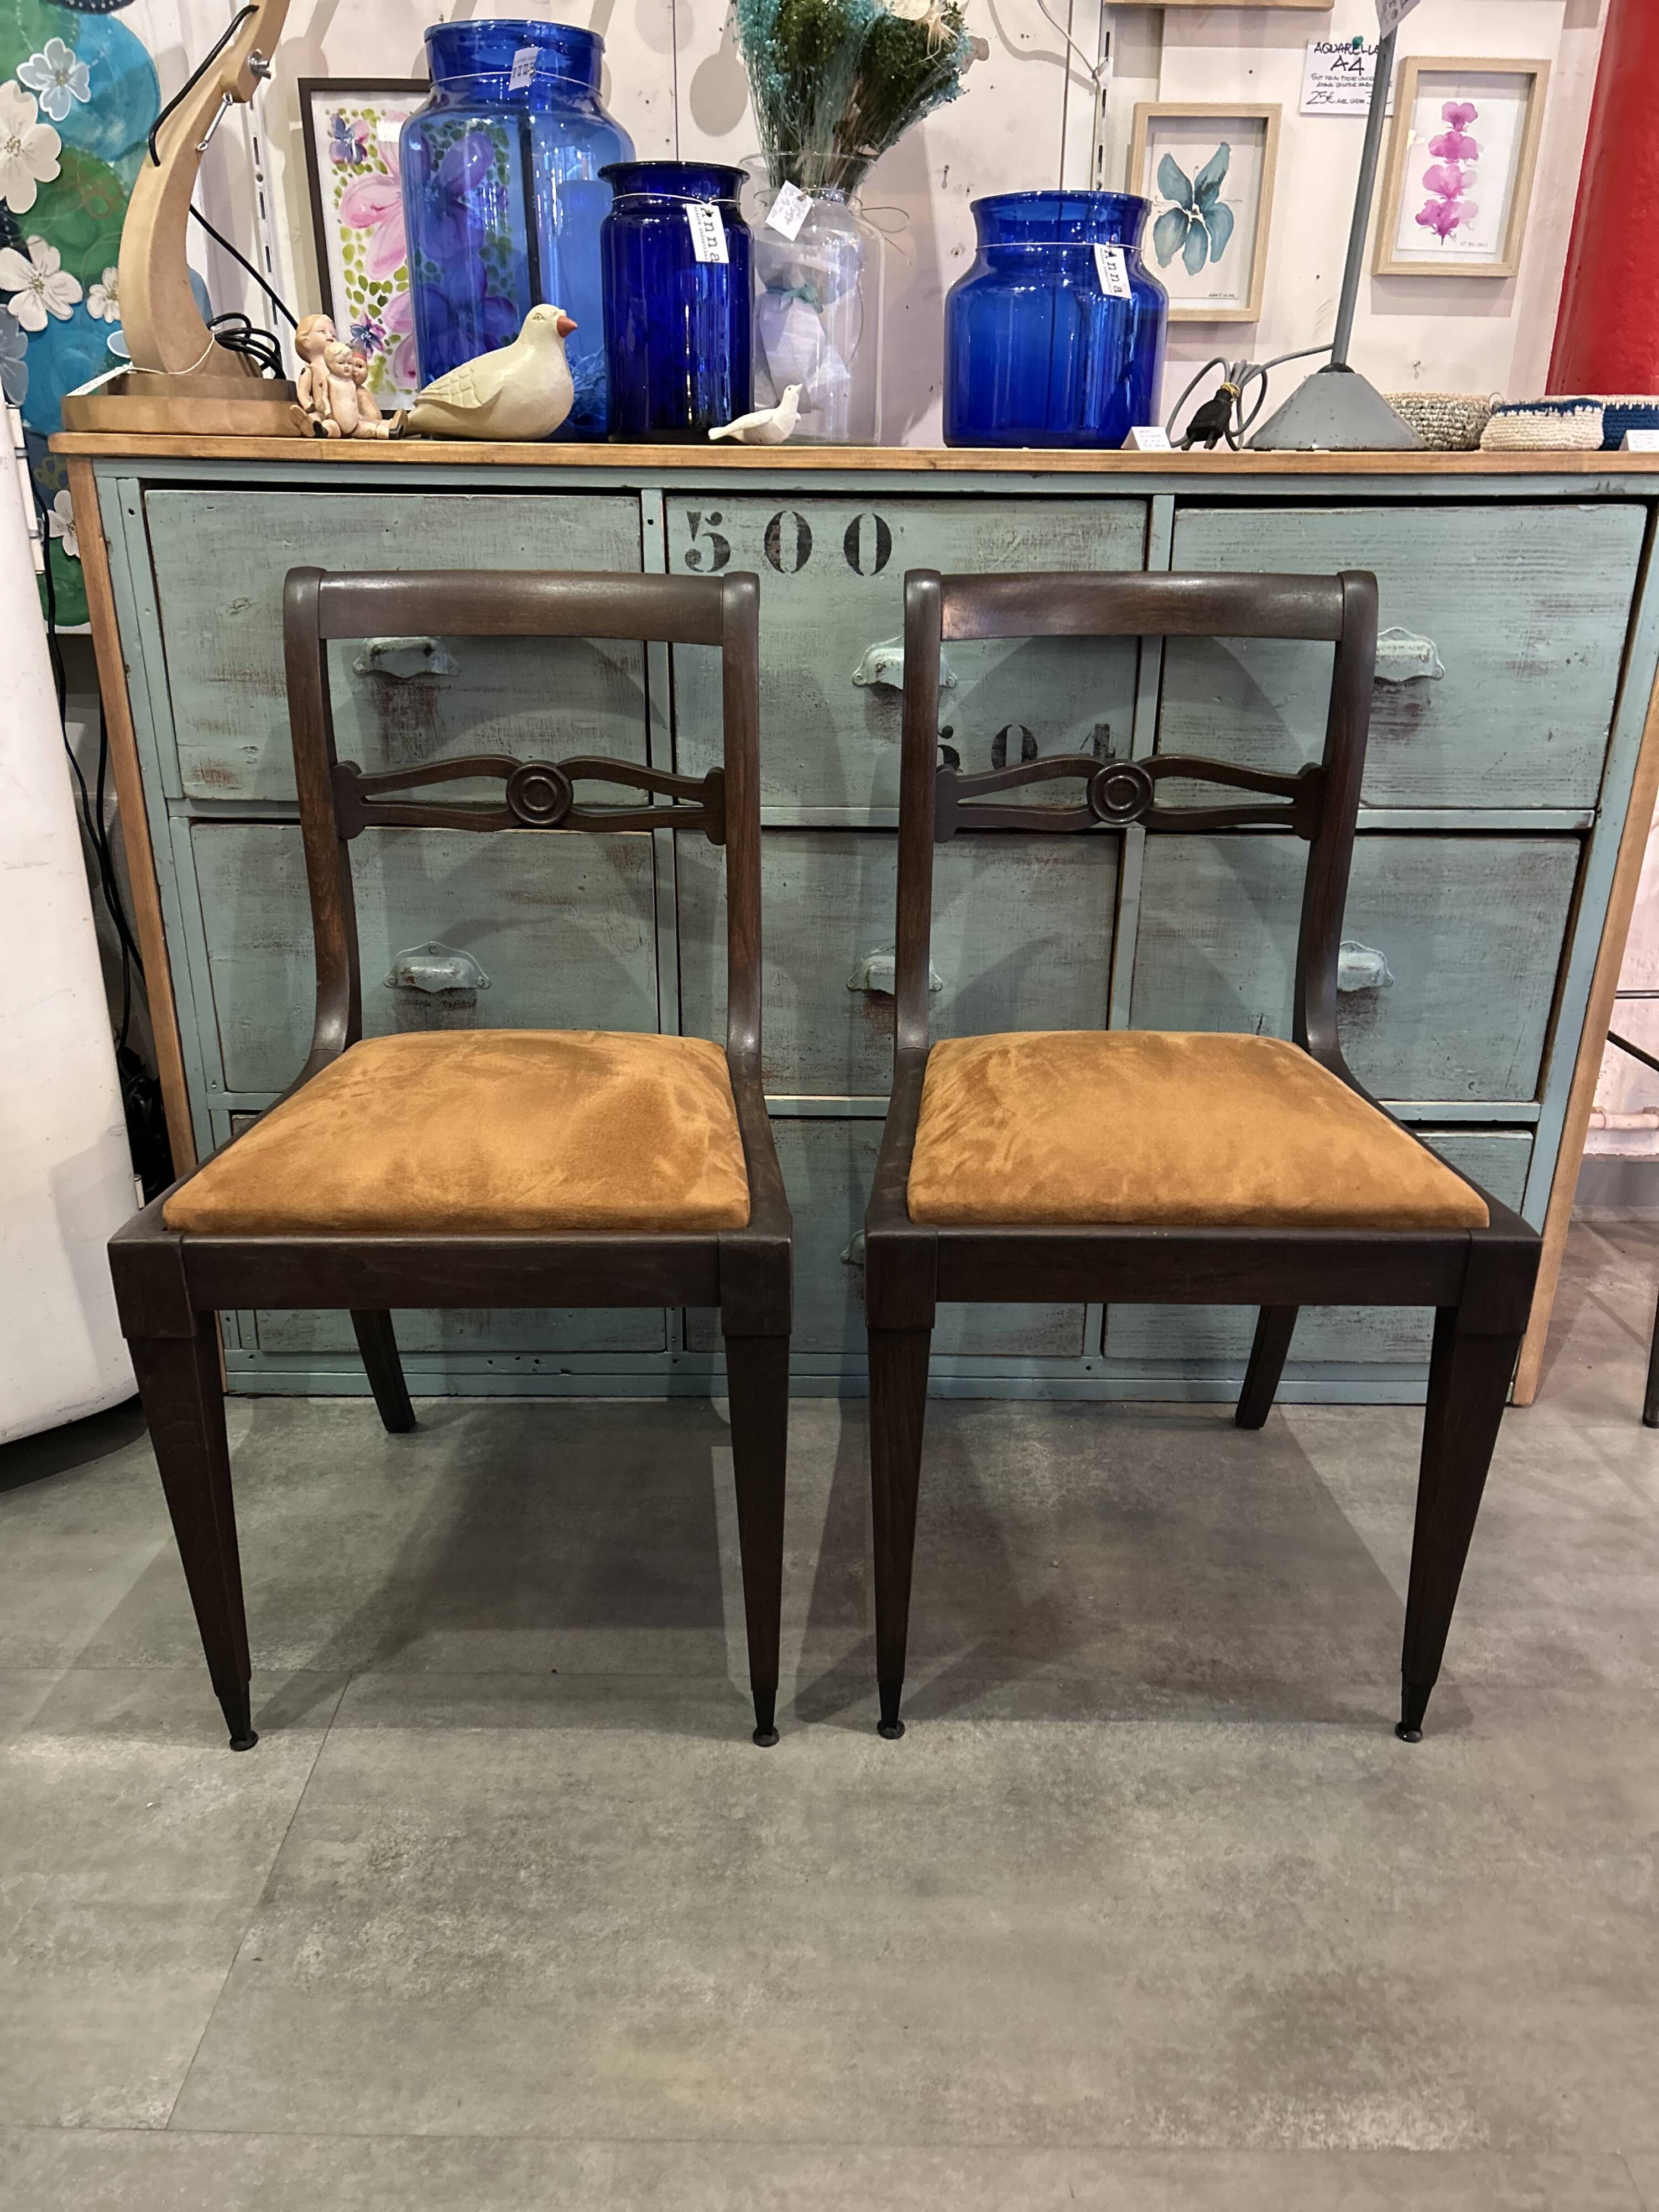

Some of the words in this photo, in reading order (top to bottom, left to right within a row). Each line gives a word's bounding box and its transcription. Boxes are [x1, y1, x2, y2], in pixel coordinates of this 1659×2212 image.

[1330, 55, 1365, 76] A4
[1306, 91, 1335, 105] 25€
[700, 207, 719, 262] Anna
[1104, 249, 1123, 293] Anna
[685, 510, 893, 577] 500
